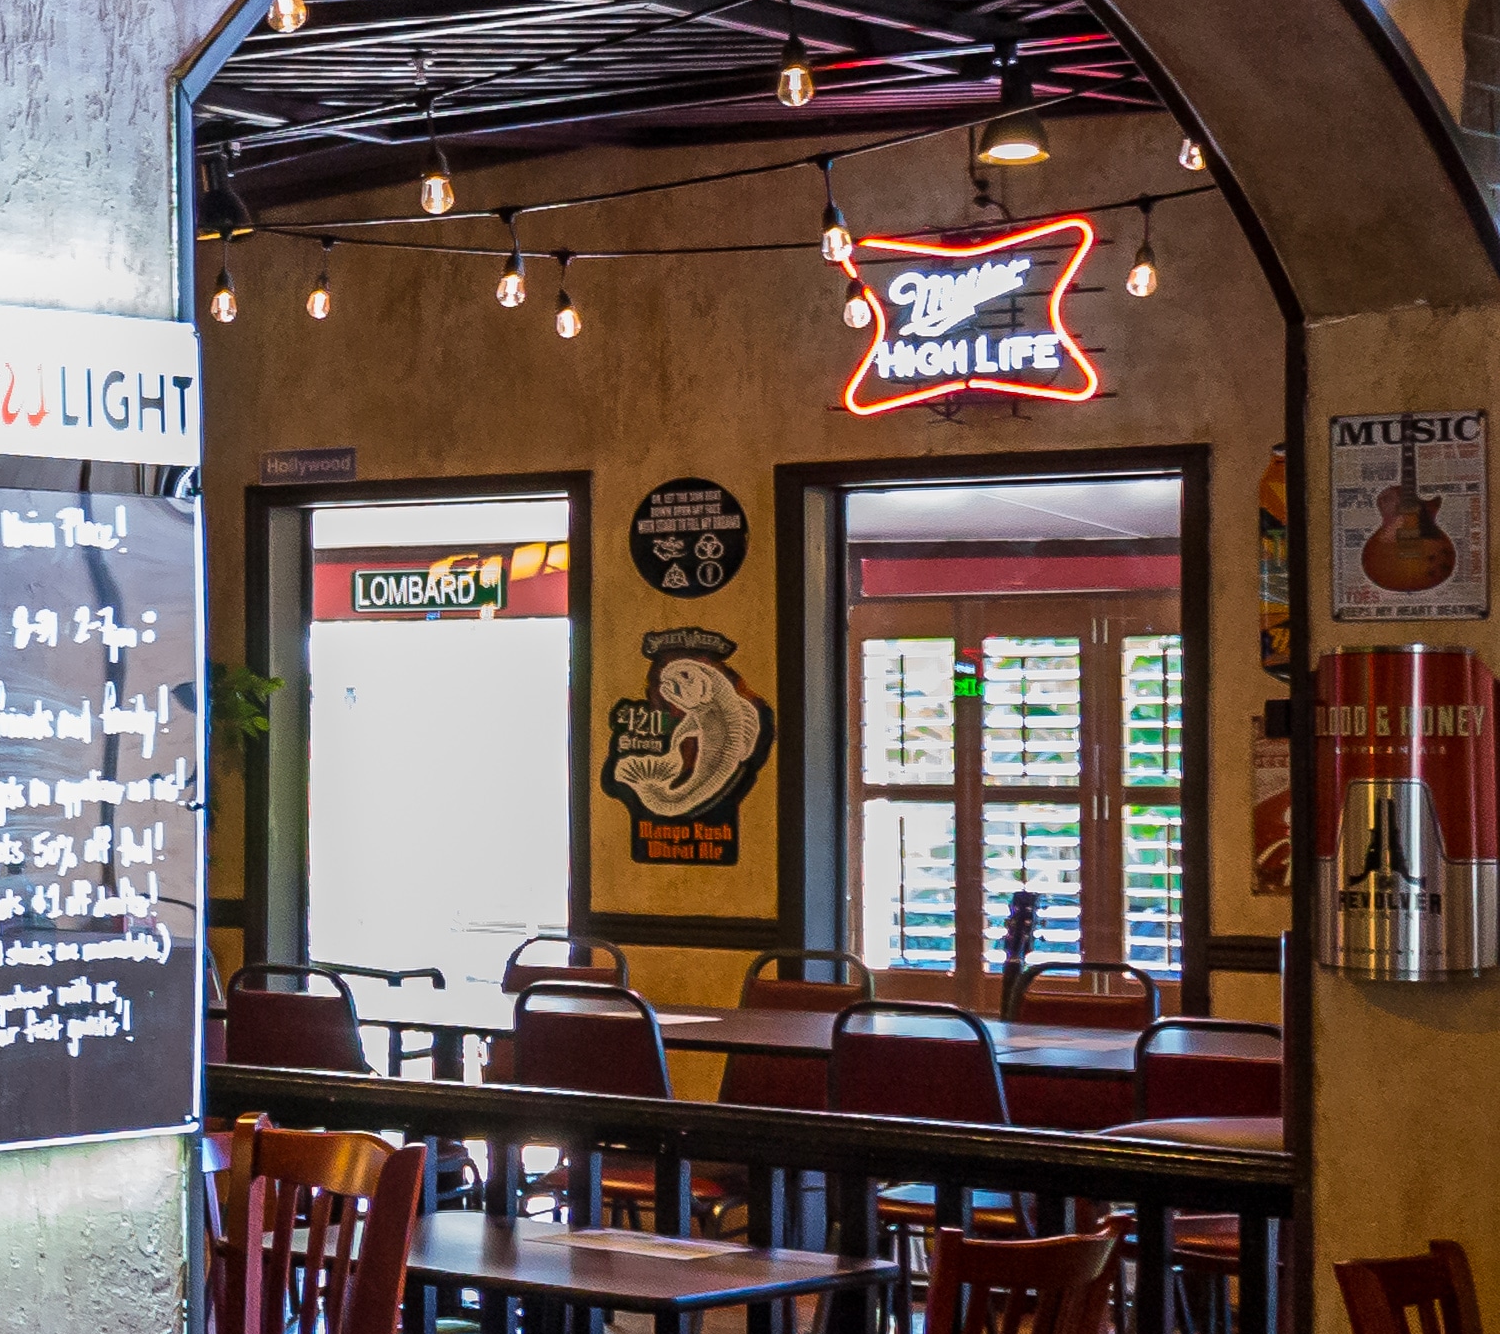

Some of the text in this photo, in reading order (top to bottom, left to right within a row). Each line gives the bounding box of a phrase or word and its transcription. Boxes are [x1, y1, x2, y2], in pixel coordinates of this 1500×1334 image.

[874, 334, 1060, 379] HIGH LIFE
[60, 366, 194, 436] LIGHT
[1336, 416, 1481, 446] MUSIC
[266, 457, 350, 475] Hollywood
[358, 575, 475, 606] LOMBARD
[1314, 705, 1485, 737] LOOD & HONEY
[618, 736, 662, 753] Strain
[639, 821, 732, 842] Mango Kush
[648, 840, 723, 860] Wheat Ale
[1338, 892, 1441, 914] REVOLVER
